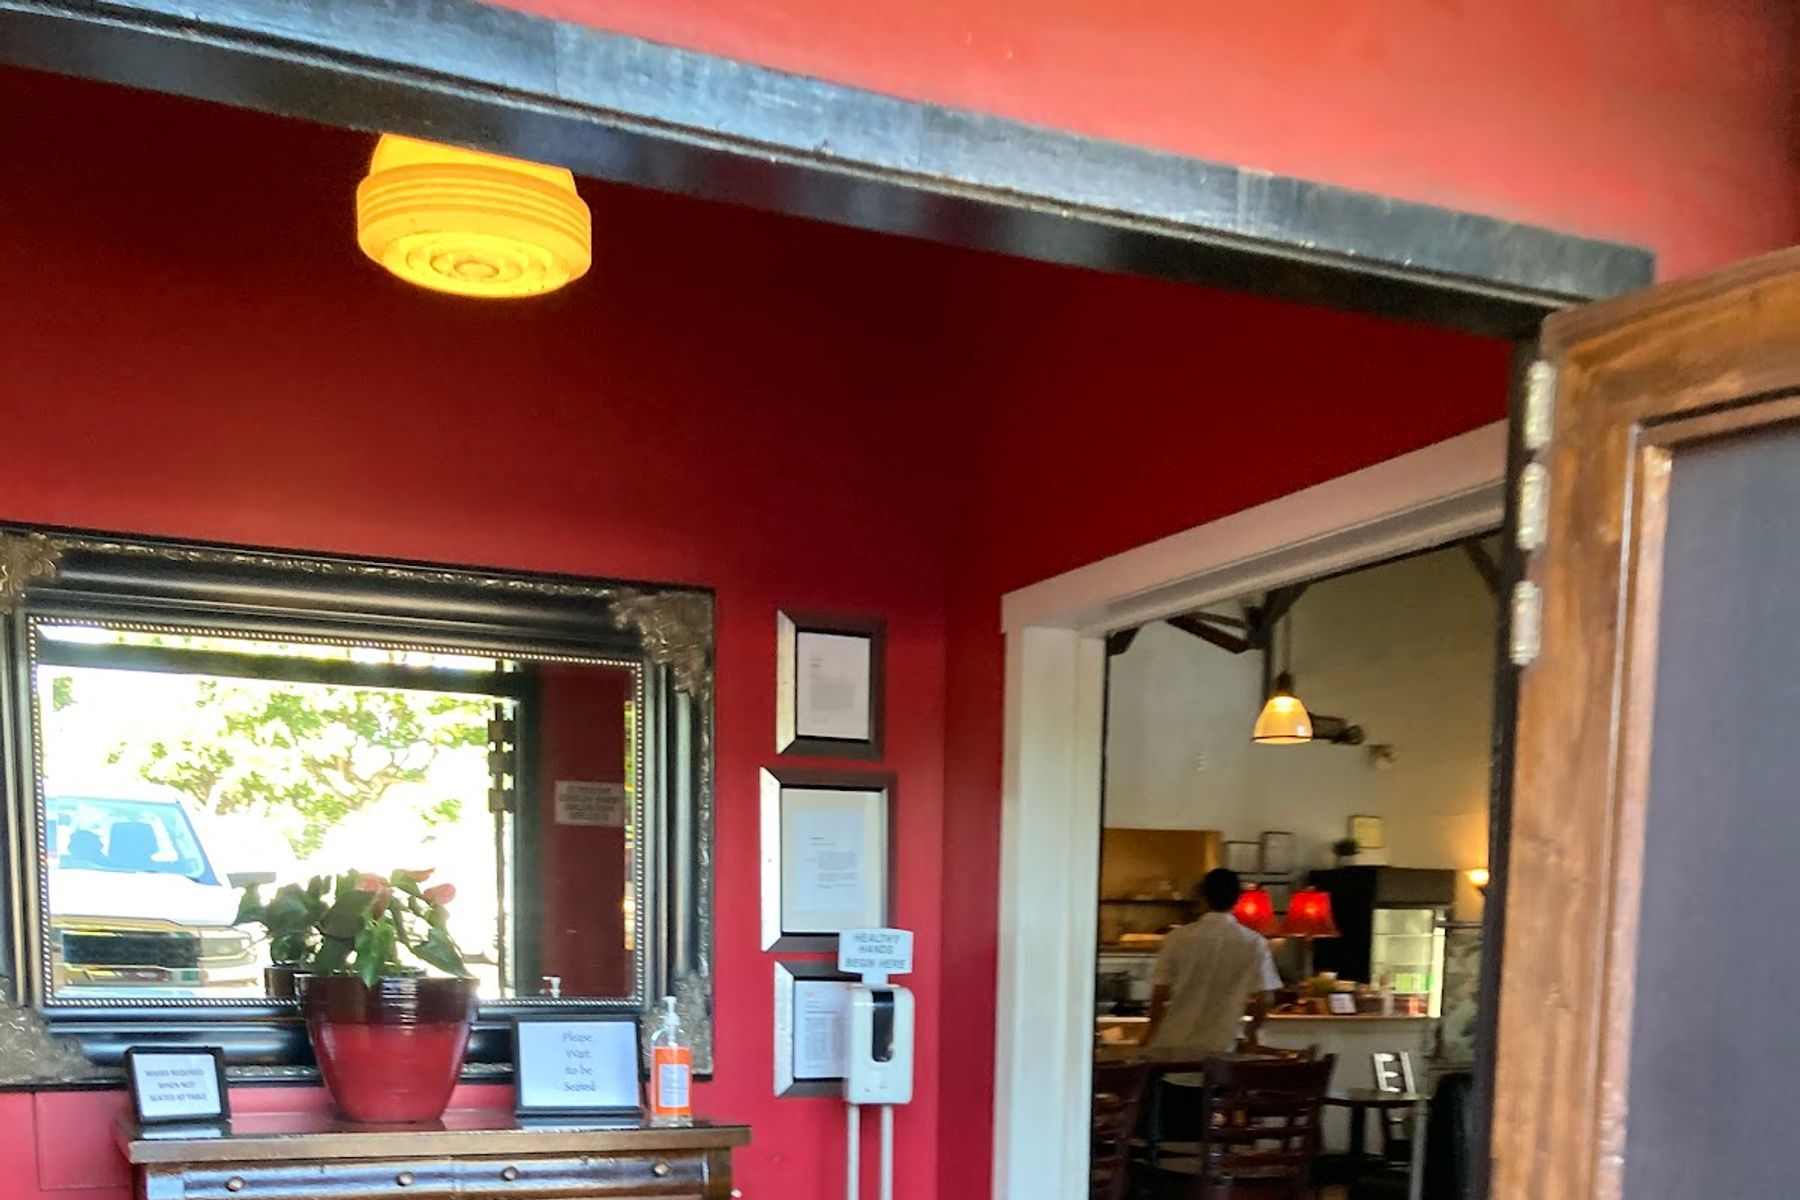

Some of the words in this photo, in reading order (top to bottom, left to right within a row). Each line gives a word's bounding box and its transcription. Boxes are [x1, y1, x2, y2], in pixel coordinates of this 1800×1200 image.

[853, 933, 901, 943] HEALTHY
[858, 944, 894, 954] HANDS
[845, 958, 874, 967] BEGIN
[879, 959, 907, 969] HERE
[562, 1031, 593, 1042] Please
[565, 1049, 592, 1059] Wait
[565, 1066, 578, 1075] to
[579, 1063, 593, 1075] be
[563, 1081, 597, 1092] Seated
